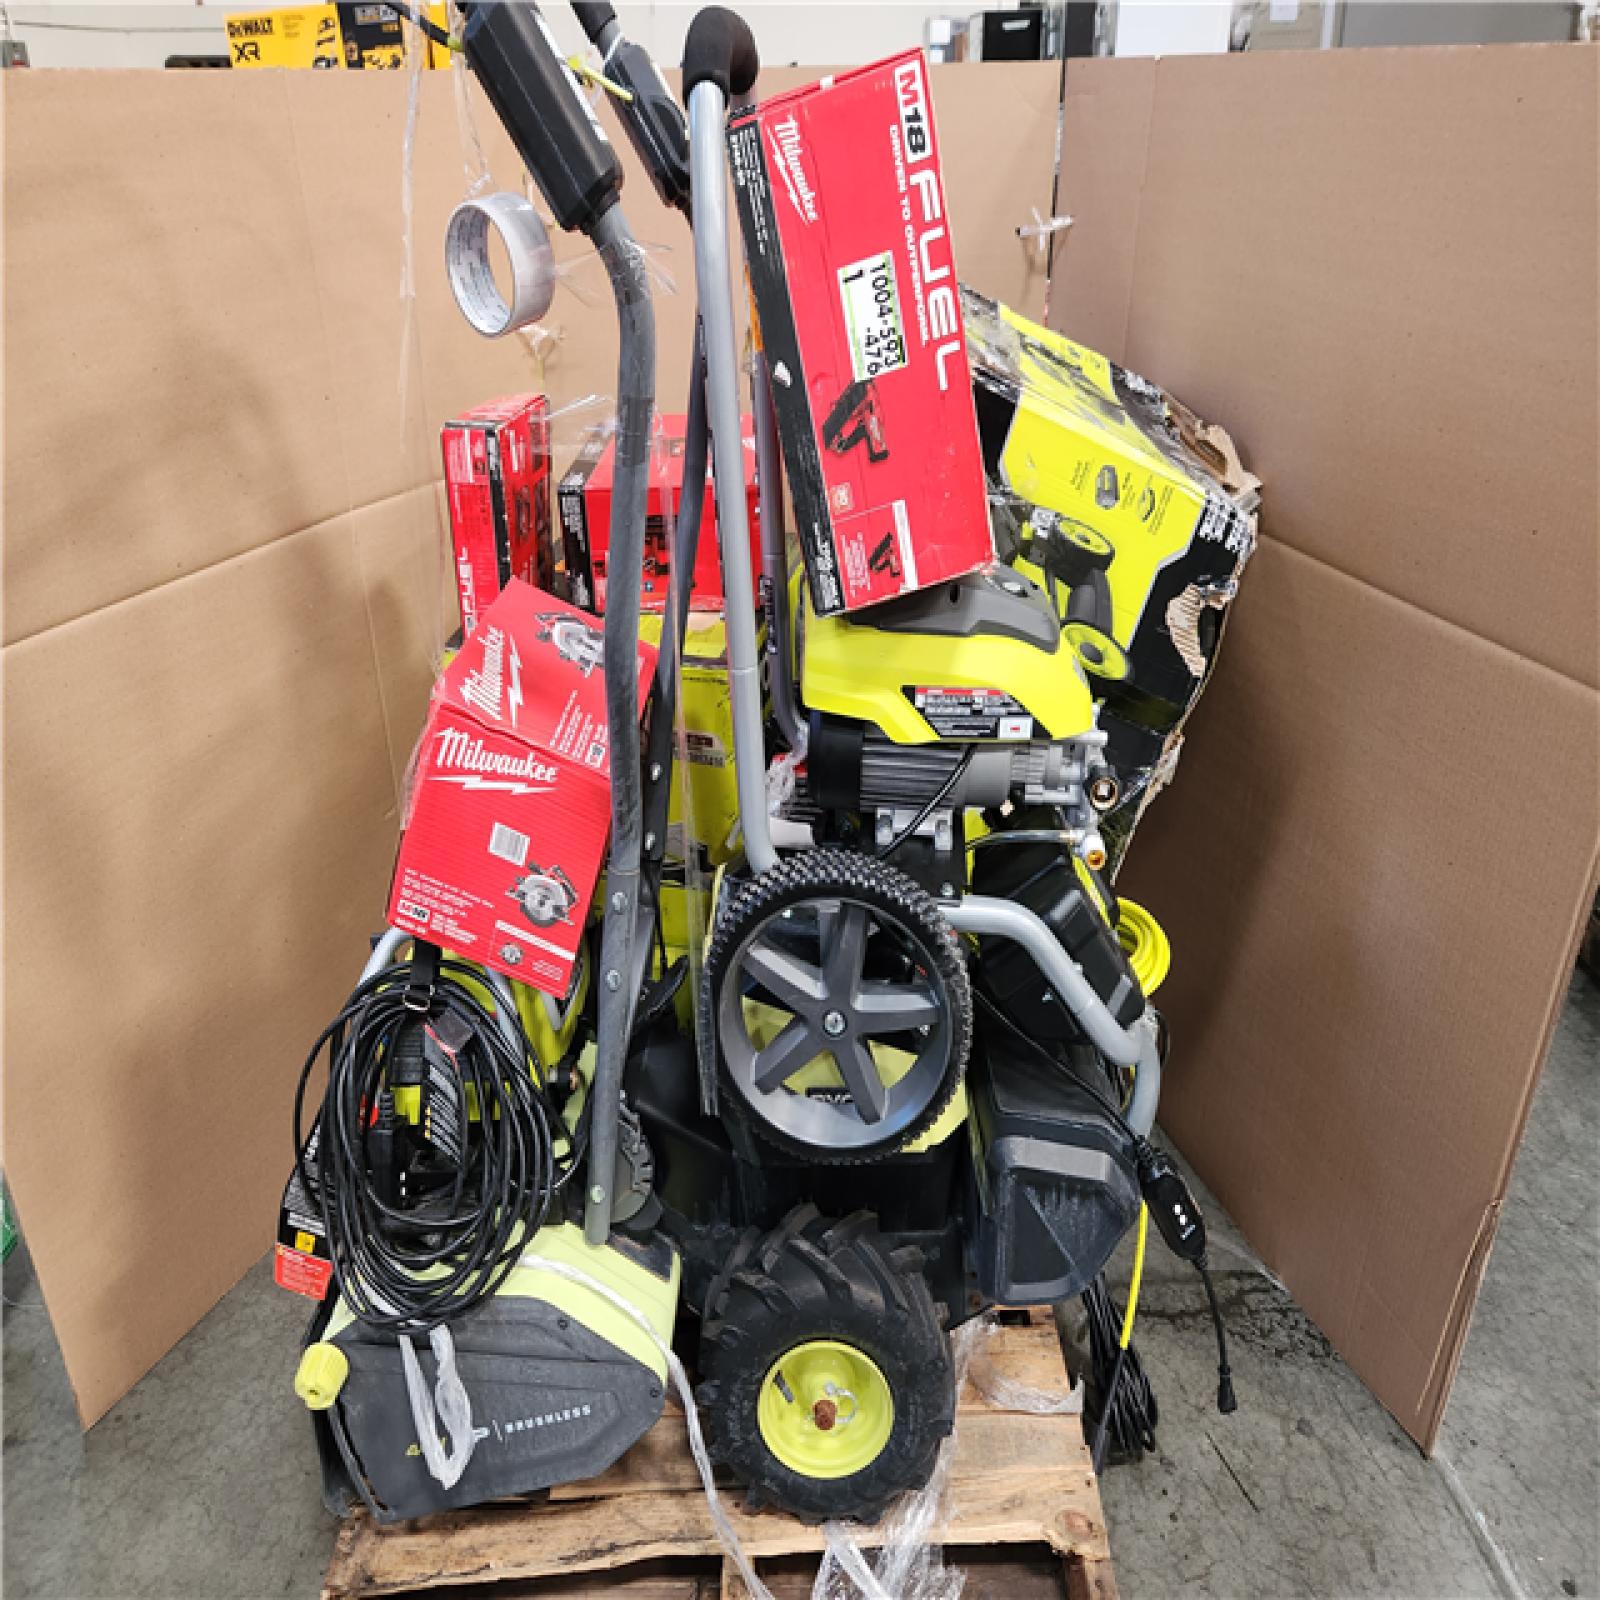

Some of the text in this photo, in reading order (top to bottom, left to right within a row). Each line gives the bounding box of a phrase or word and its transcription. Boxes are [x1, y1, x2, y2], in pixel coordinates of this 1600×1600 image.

[233, 41, 261, 63] XR
[773, 115, 819, 222] Milwaukee
[897, 69, 961, 391] M18 FUEL
[457, 546, 476, 614] FUEL
[458, 625, 505, 721] Milwaukee
[435, 726, 560, 783] Milwaukee
[504, 1404, 591, 1432] BRUSHLESS
